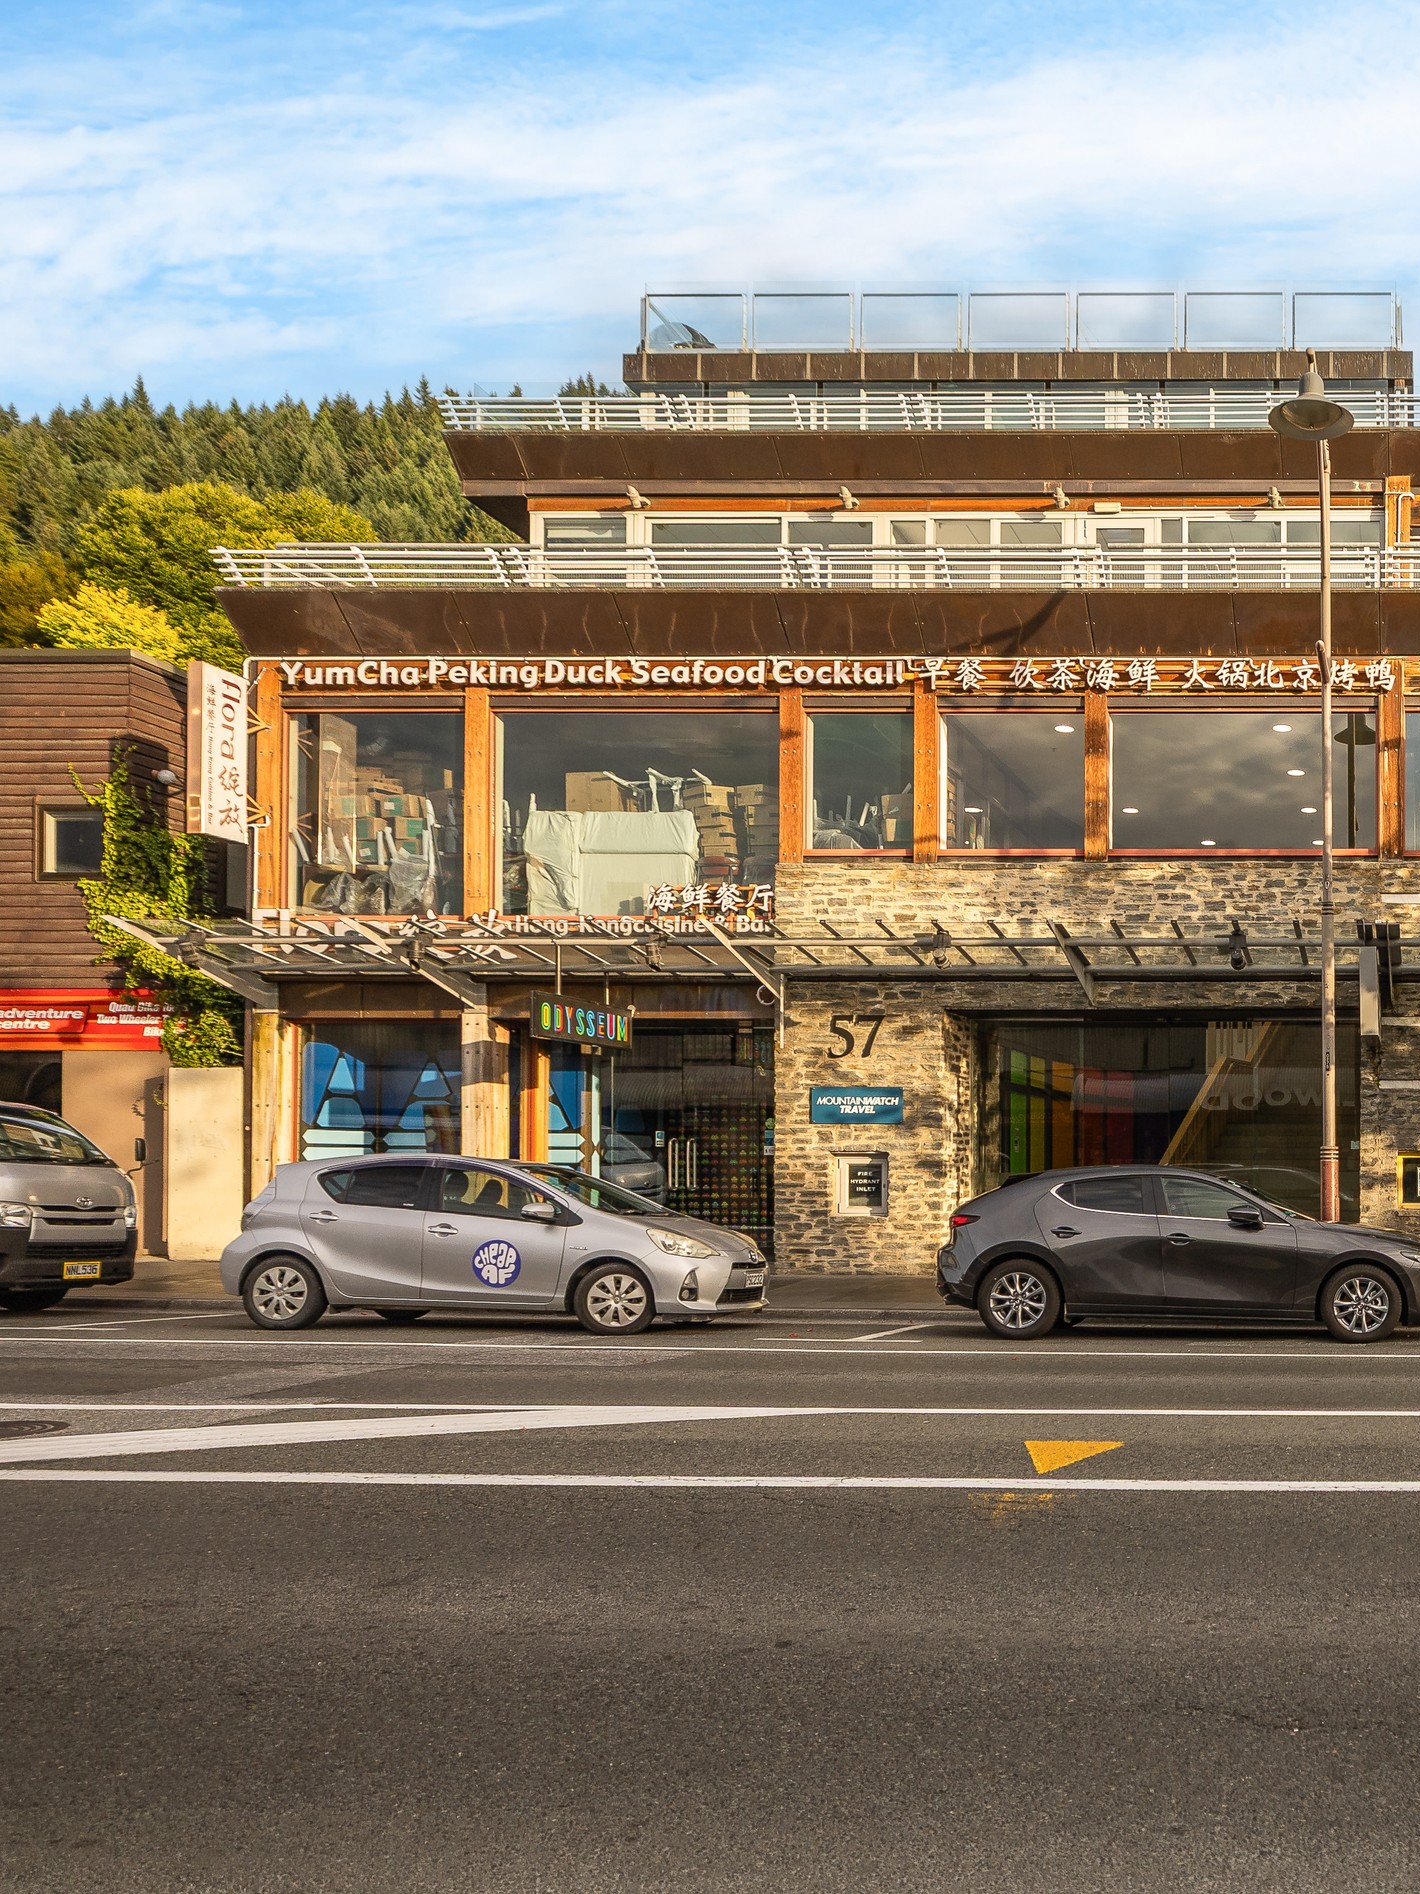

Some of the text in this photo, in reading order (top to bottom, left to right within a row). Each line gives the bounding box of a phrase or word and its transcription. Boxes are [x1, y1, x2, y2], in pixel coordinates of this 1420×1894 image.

[428, 660, 538, 688] Peking
[544, 660, 625, 685] Duck
[631, 660, 766, 686] Seafood
[772, 660, 906, 686] Cocktail
[918, 657, 987, 691] 早餐
[648, 882, 775, 914] 海鲜餐厅
[516, 914, 569, 936] Hong
[97, 1014, 118, 1025] Two
[541, 1002, 629, 1042] ODYSSEUM
[827, 1014, 886, 1059] 57
[817, 1096, 899, 1106] MOUNTAINWATCH
[840, 1105, 876, 1114] TRAVEL
[481, 1264, 516, 1285] AF
